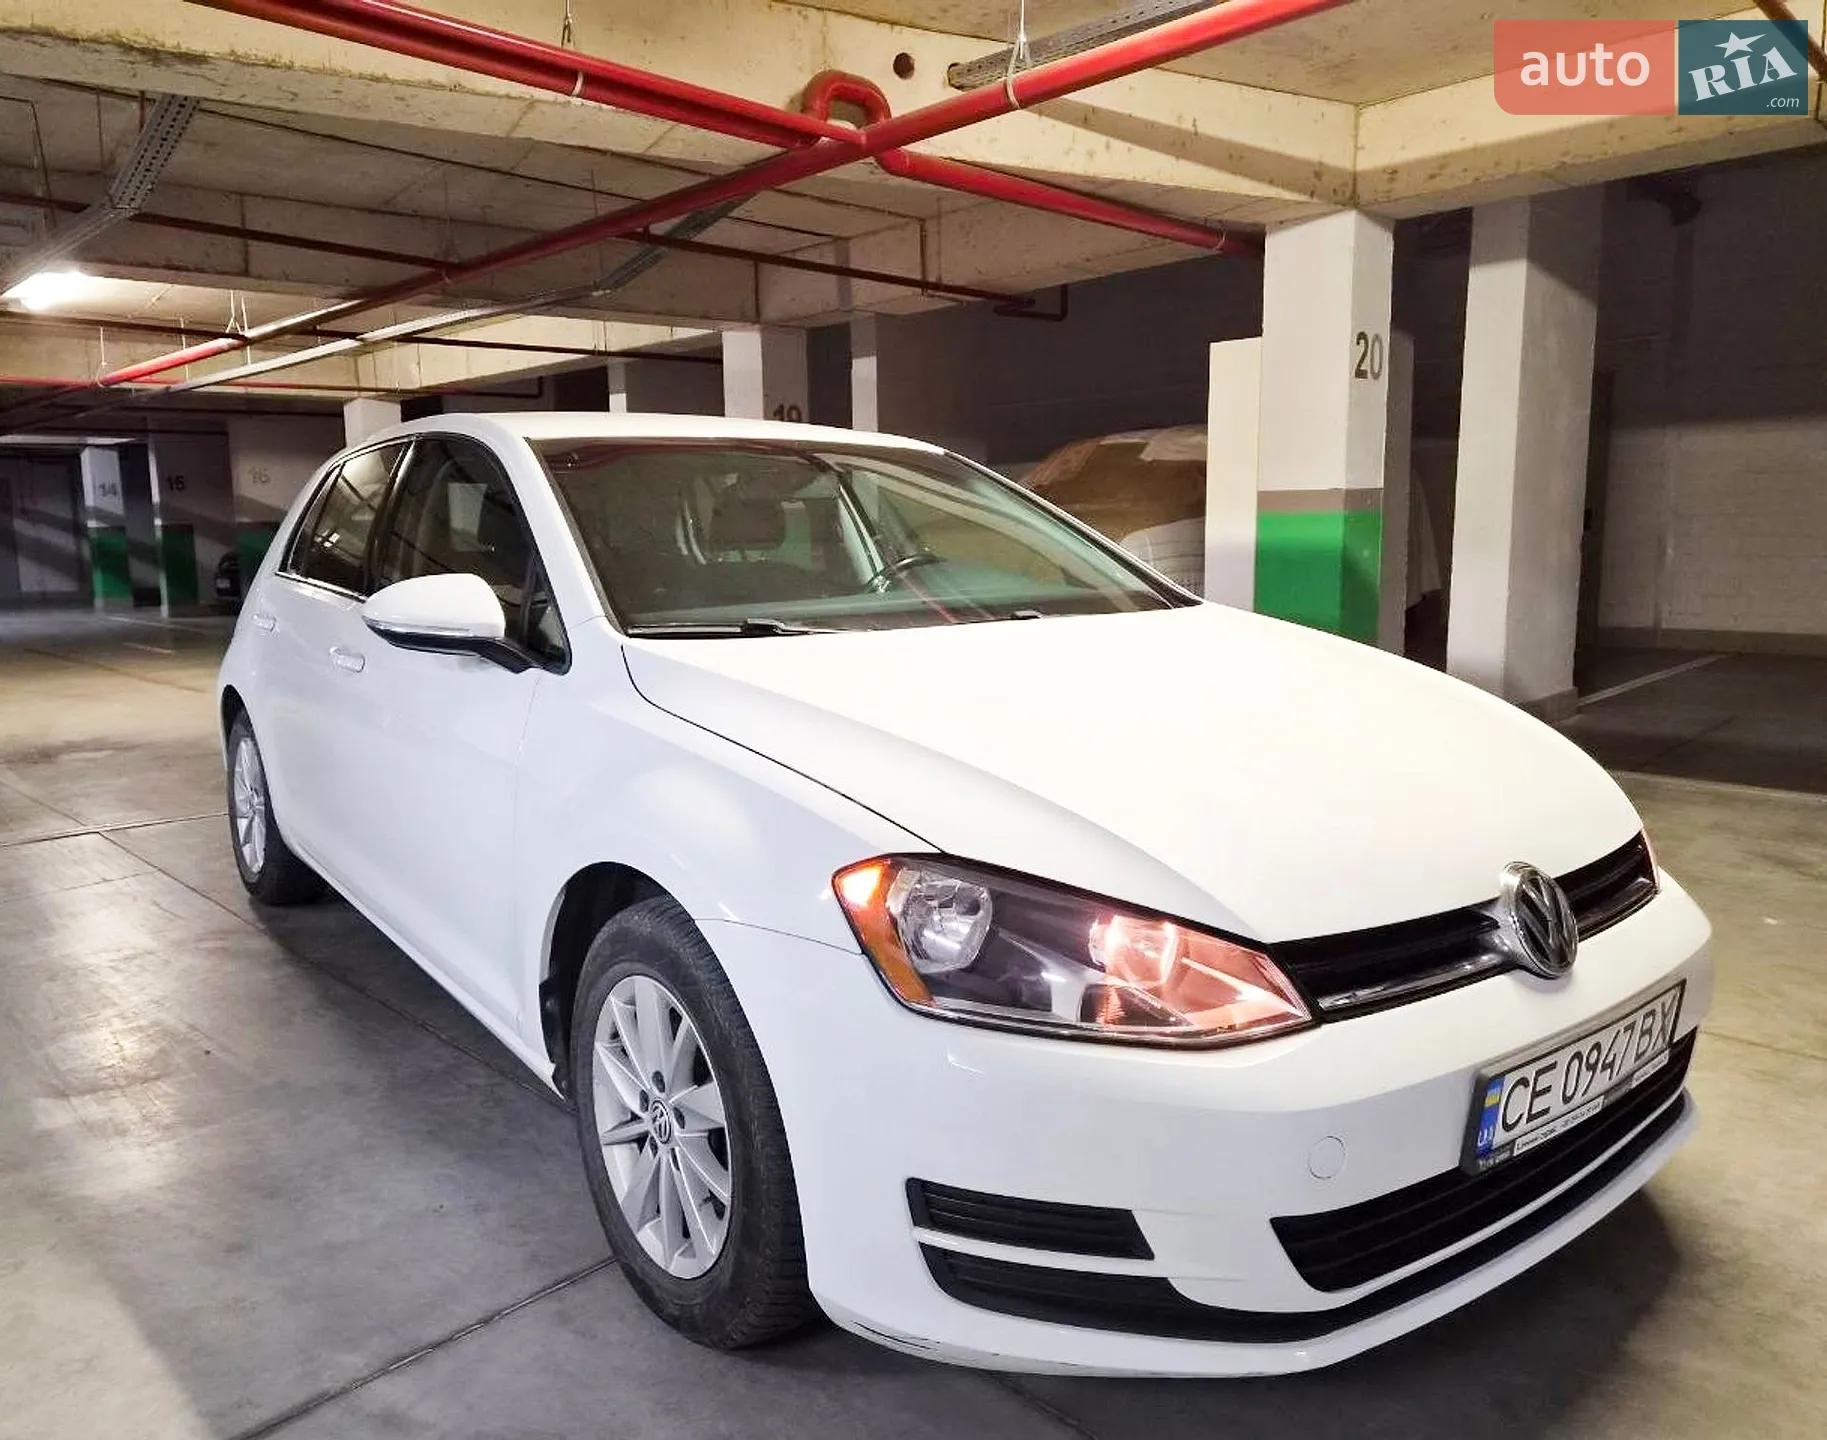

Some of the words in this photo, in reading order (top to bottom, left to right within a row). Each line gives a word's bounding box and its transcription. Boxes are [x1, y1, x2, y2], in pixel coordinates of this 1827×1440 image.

[1355, 331, 1384, 380] 20
[1502, 1061, 1558, 1132] CE
[1561, 1020, 1637, 1104] 0947
[1634, 992, 1677, 1064] BX
